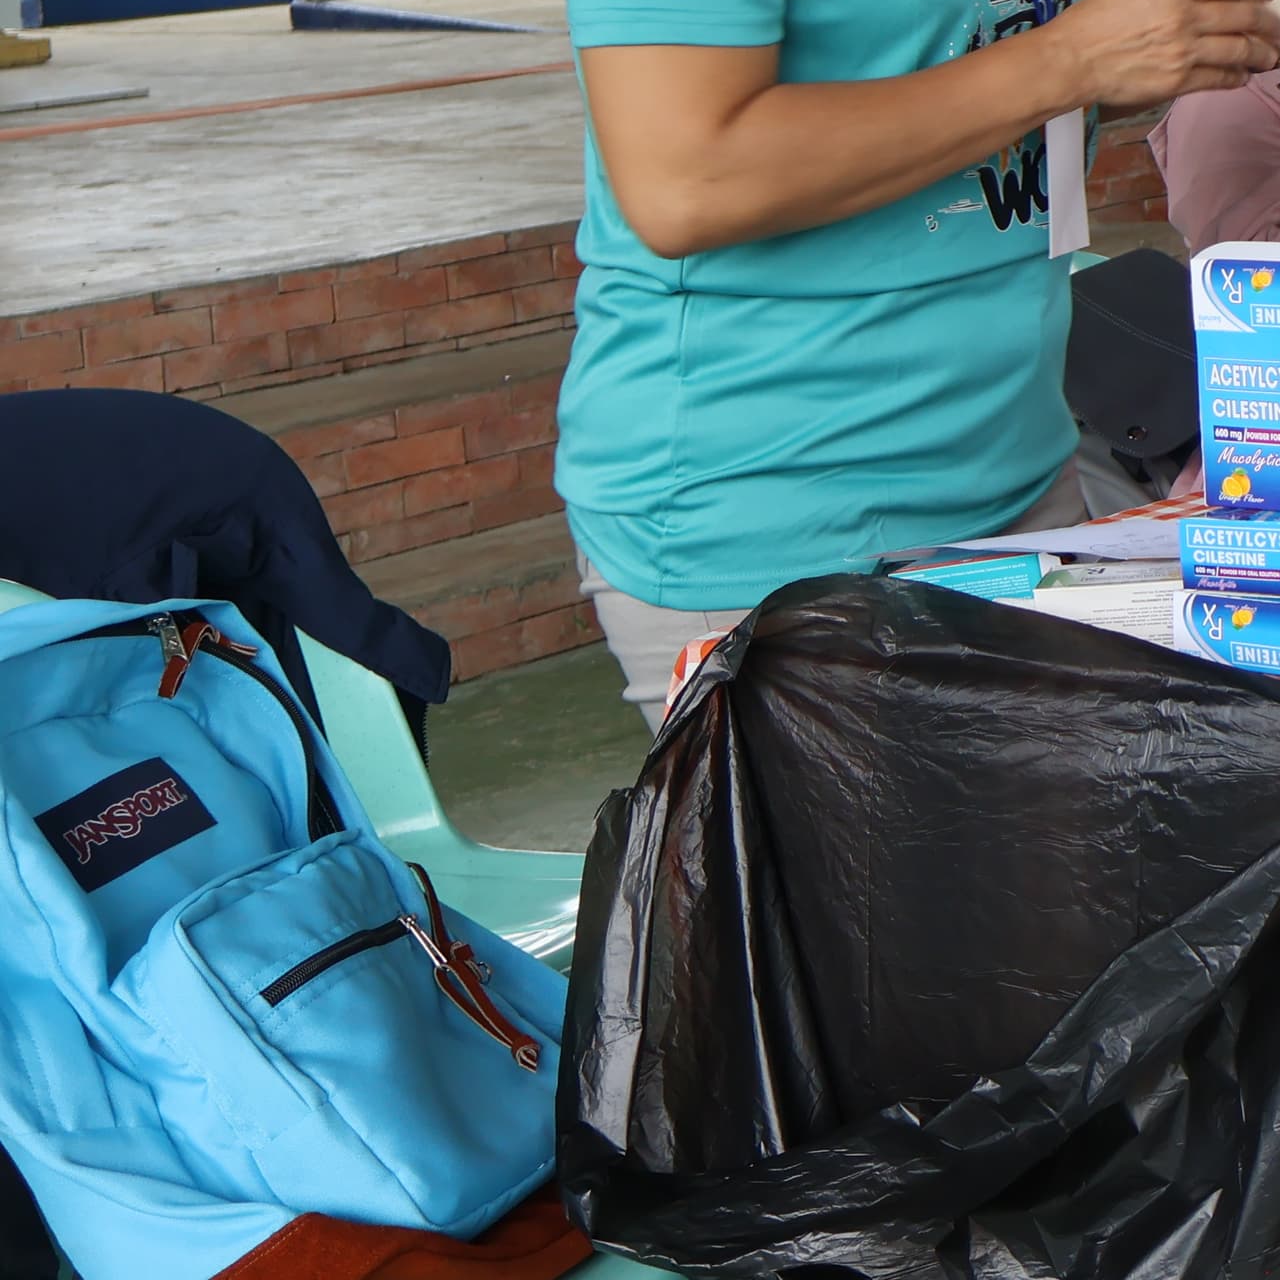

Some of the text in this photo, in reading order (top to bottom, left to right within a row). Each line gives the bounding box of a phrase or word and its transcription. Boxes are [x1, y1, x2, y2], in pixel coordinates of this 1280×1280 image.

[1215, 429, 1228, 438] 600
[1230, 431, 1242, 440] mg
[1193, 550, 1266, 566] CILESTINE
[63, 777, 184, 864] JANSPORT
